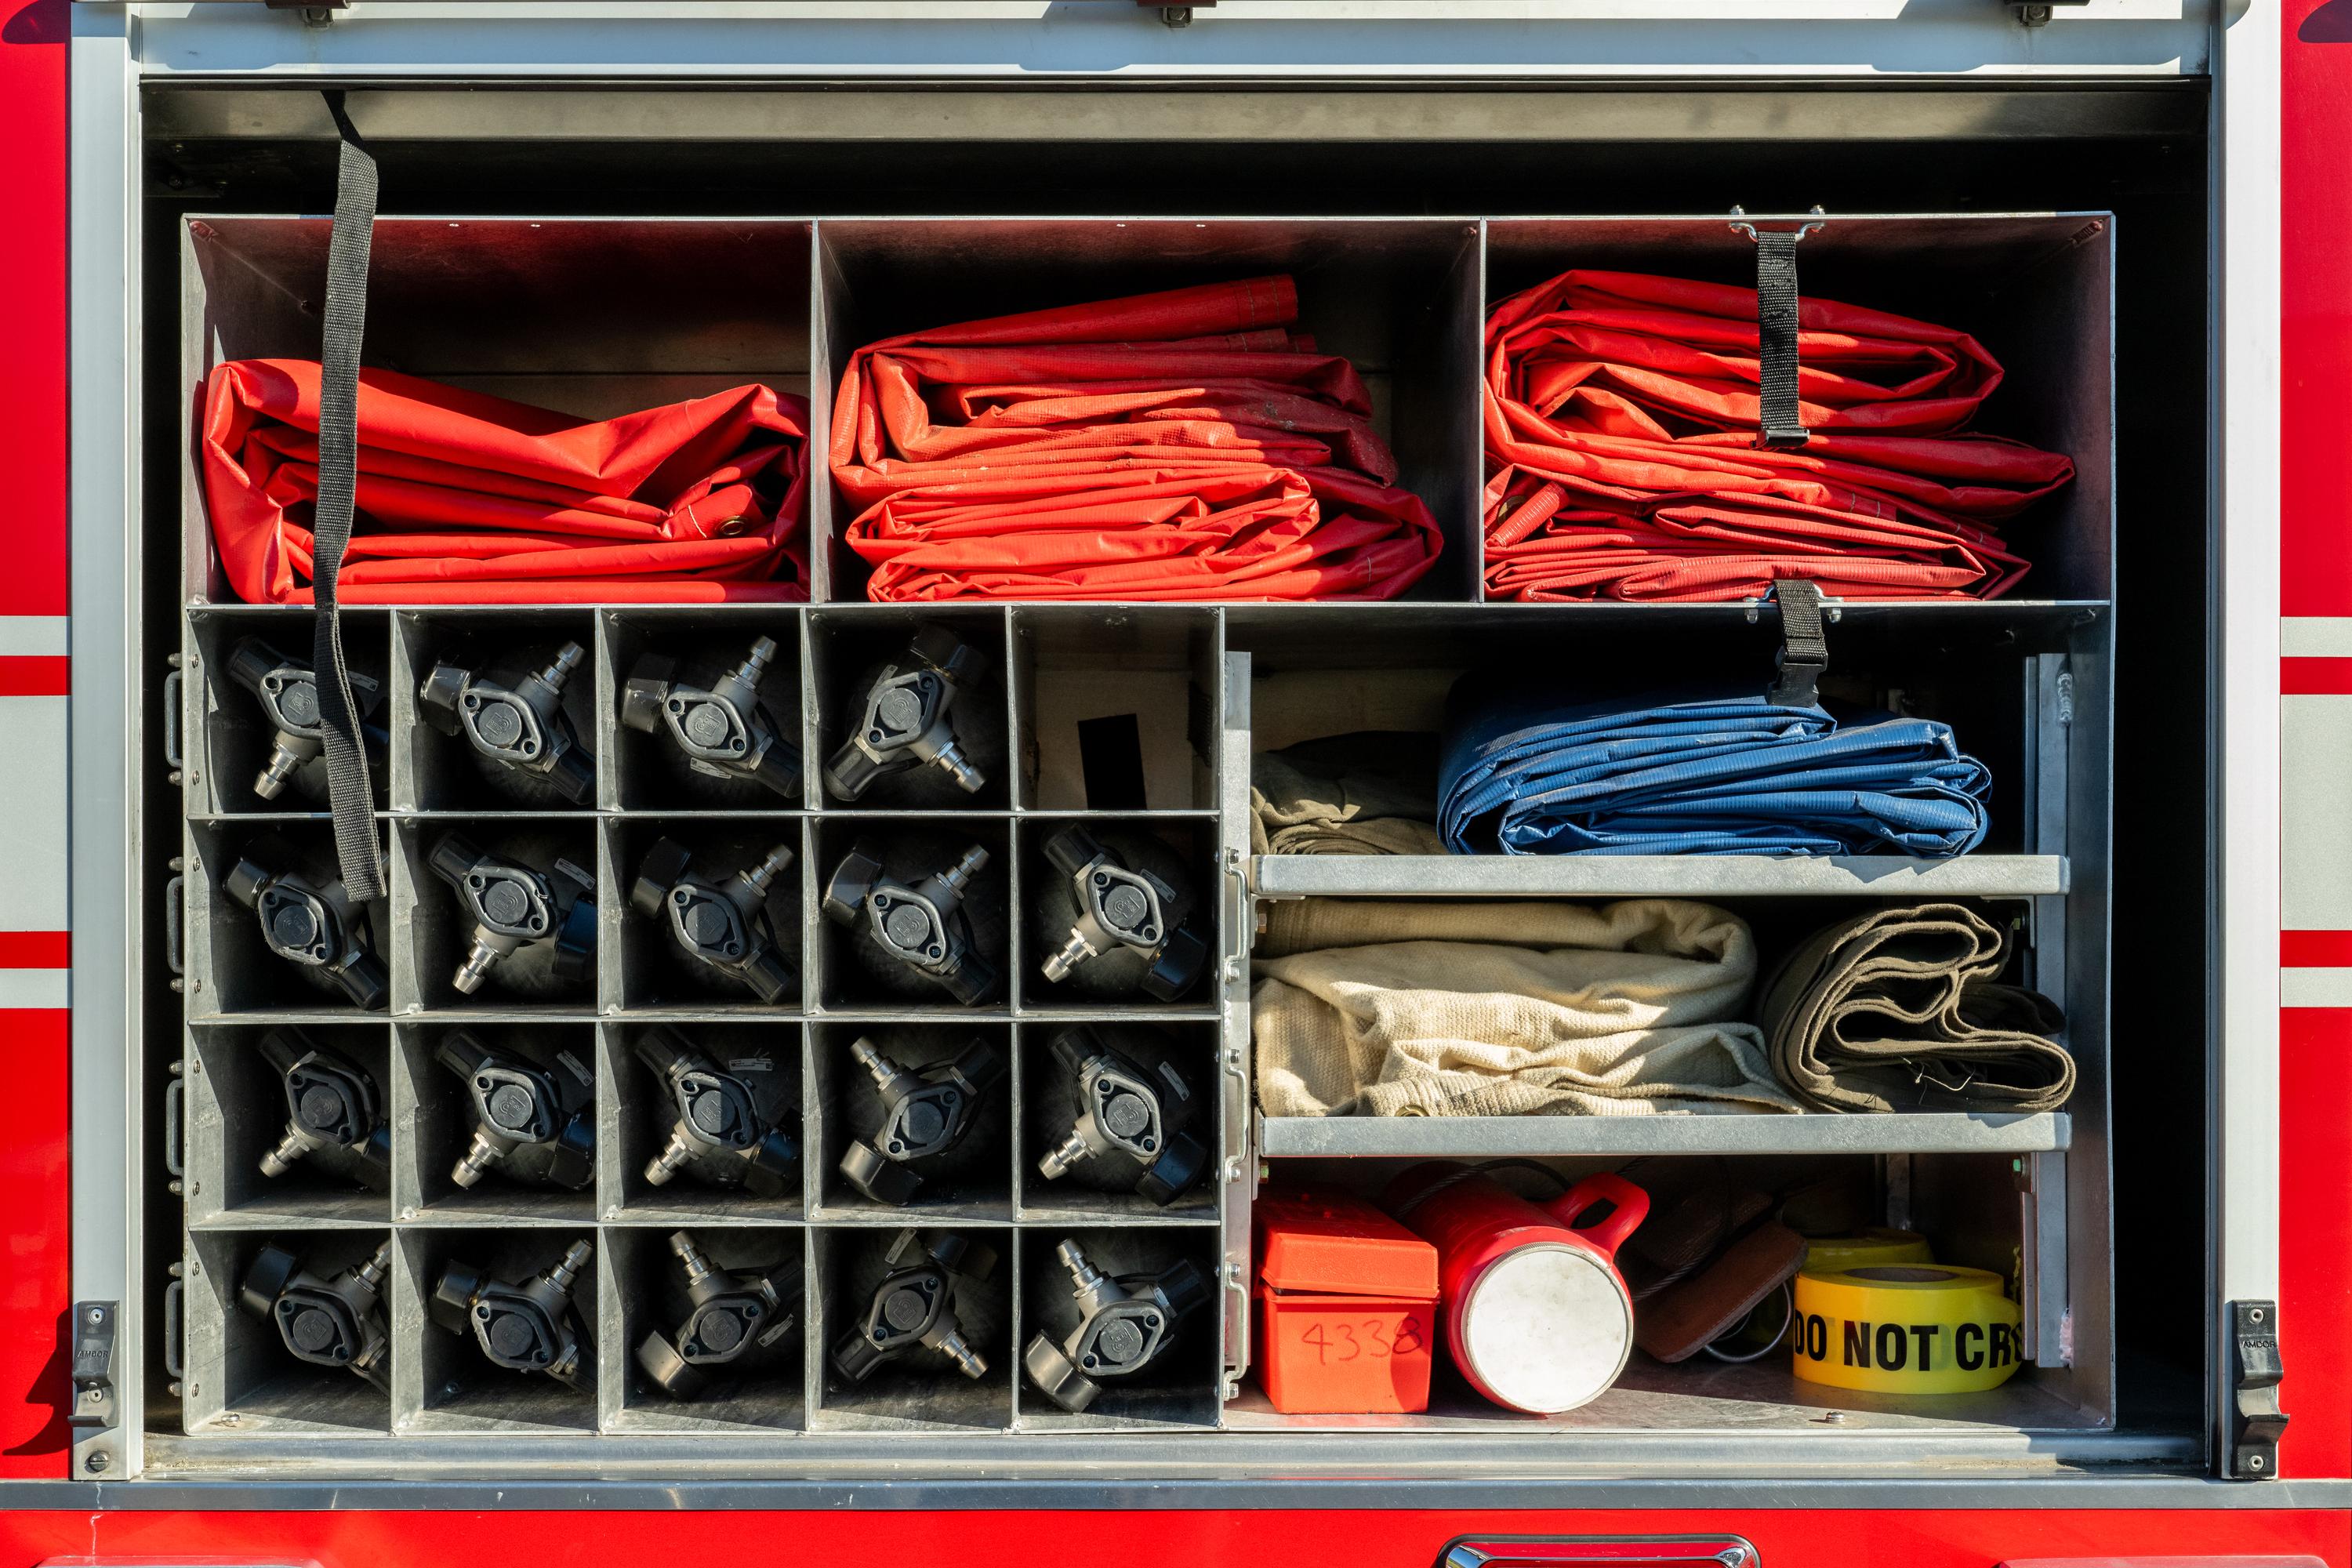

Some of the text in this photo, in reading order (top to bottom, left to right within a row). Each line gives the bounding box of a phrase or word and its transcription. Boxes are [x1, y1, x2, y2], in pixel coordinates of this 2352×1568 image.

[1301, 1316, 1423, 1366] 4338
[1795, 1309, 1827, 1361] DO
[1844, 1320, 1939, 1371] NOT
